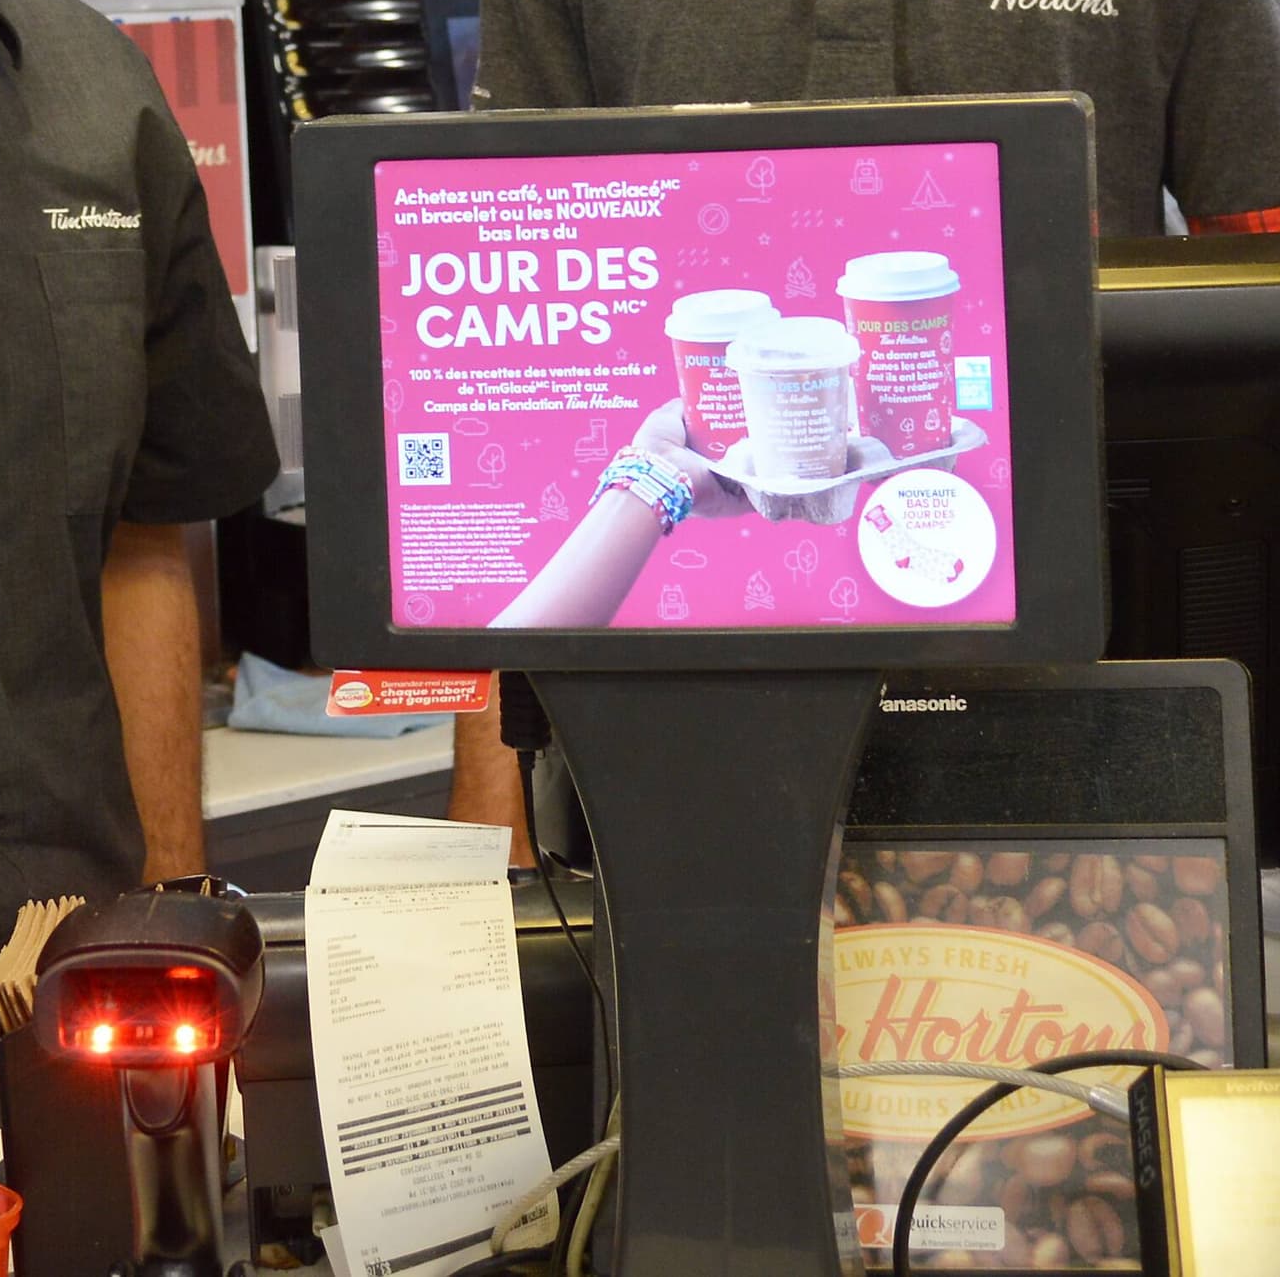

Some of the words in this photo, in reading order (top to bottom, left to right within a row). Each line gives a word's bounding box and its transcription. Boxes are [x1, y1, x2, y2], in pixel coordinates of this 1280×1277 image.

[394, 188, 468, 205] Achetez
[471, 190, 494, 203] un
[497, 184, 543, 205] café,
[546, 187, 569, 201] un
[395, 211, 418, 225] un
[421, 205, 497, 224] bracelet
[500, 207, 524, 221] ou
[527, 204, 553, 221] les
[556, 200, 662, 220] NOUVEAUX
[478, 225, 512, 242] bas
[516, 224, 549, 241] lors
[552, 223, 577, 240] du
[401, 250, 541, 297] JOUR
[556, 247, 660, 291] DES
[416, 300, 612, 349] CAMPS
[409, 369, 431, 382] 100
[445, 368, 468, 381] des
[470, 367, 521, 380] recettes
[524, 366, 546, 378] des
[548, 366, 590, 378] ventes
[593, 364, 610, 377] de
[612, 363, 641, 377] café
[643, 364, 657, 376] et
[458, 384, 474, 395] de
[552, 381, 582, 394] iront
[584, 382, 608, 393] aux
[423, 400, 468, 415] Camps
[470, 399, 486, 412] de
[488, 399, 500, 412] la
[502, 397, 564, 411] Fondation
[564, 393, 588, 410] Tim
[381, 688, 428, 699] chaque
[431, 686, 475, 696] rebord
[384, 696, 403, 705] est
[880, 694, 968, 712] anasonic
[944, 946, 1029, 978] FRESH
[858, 973, 1147, 1063] Hortons
